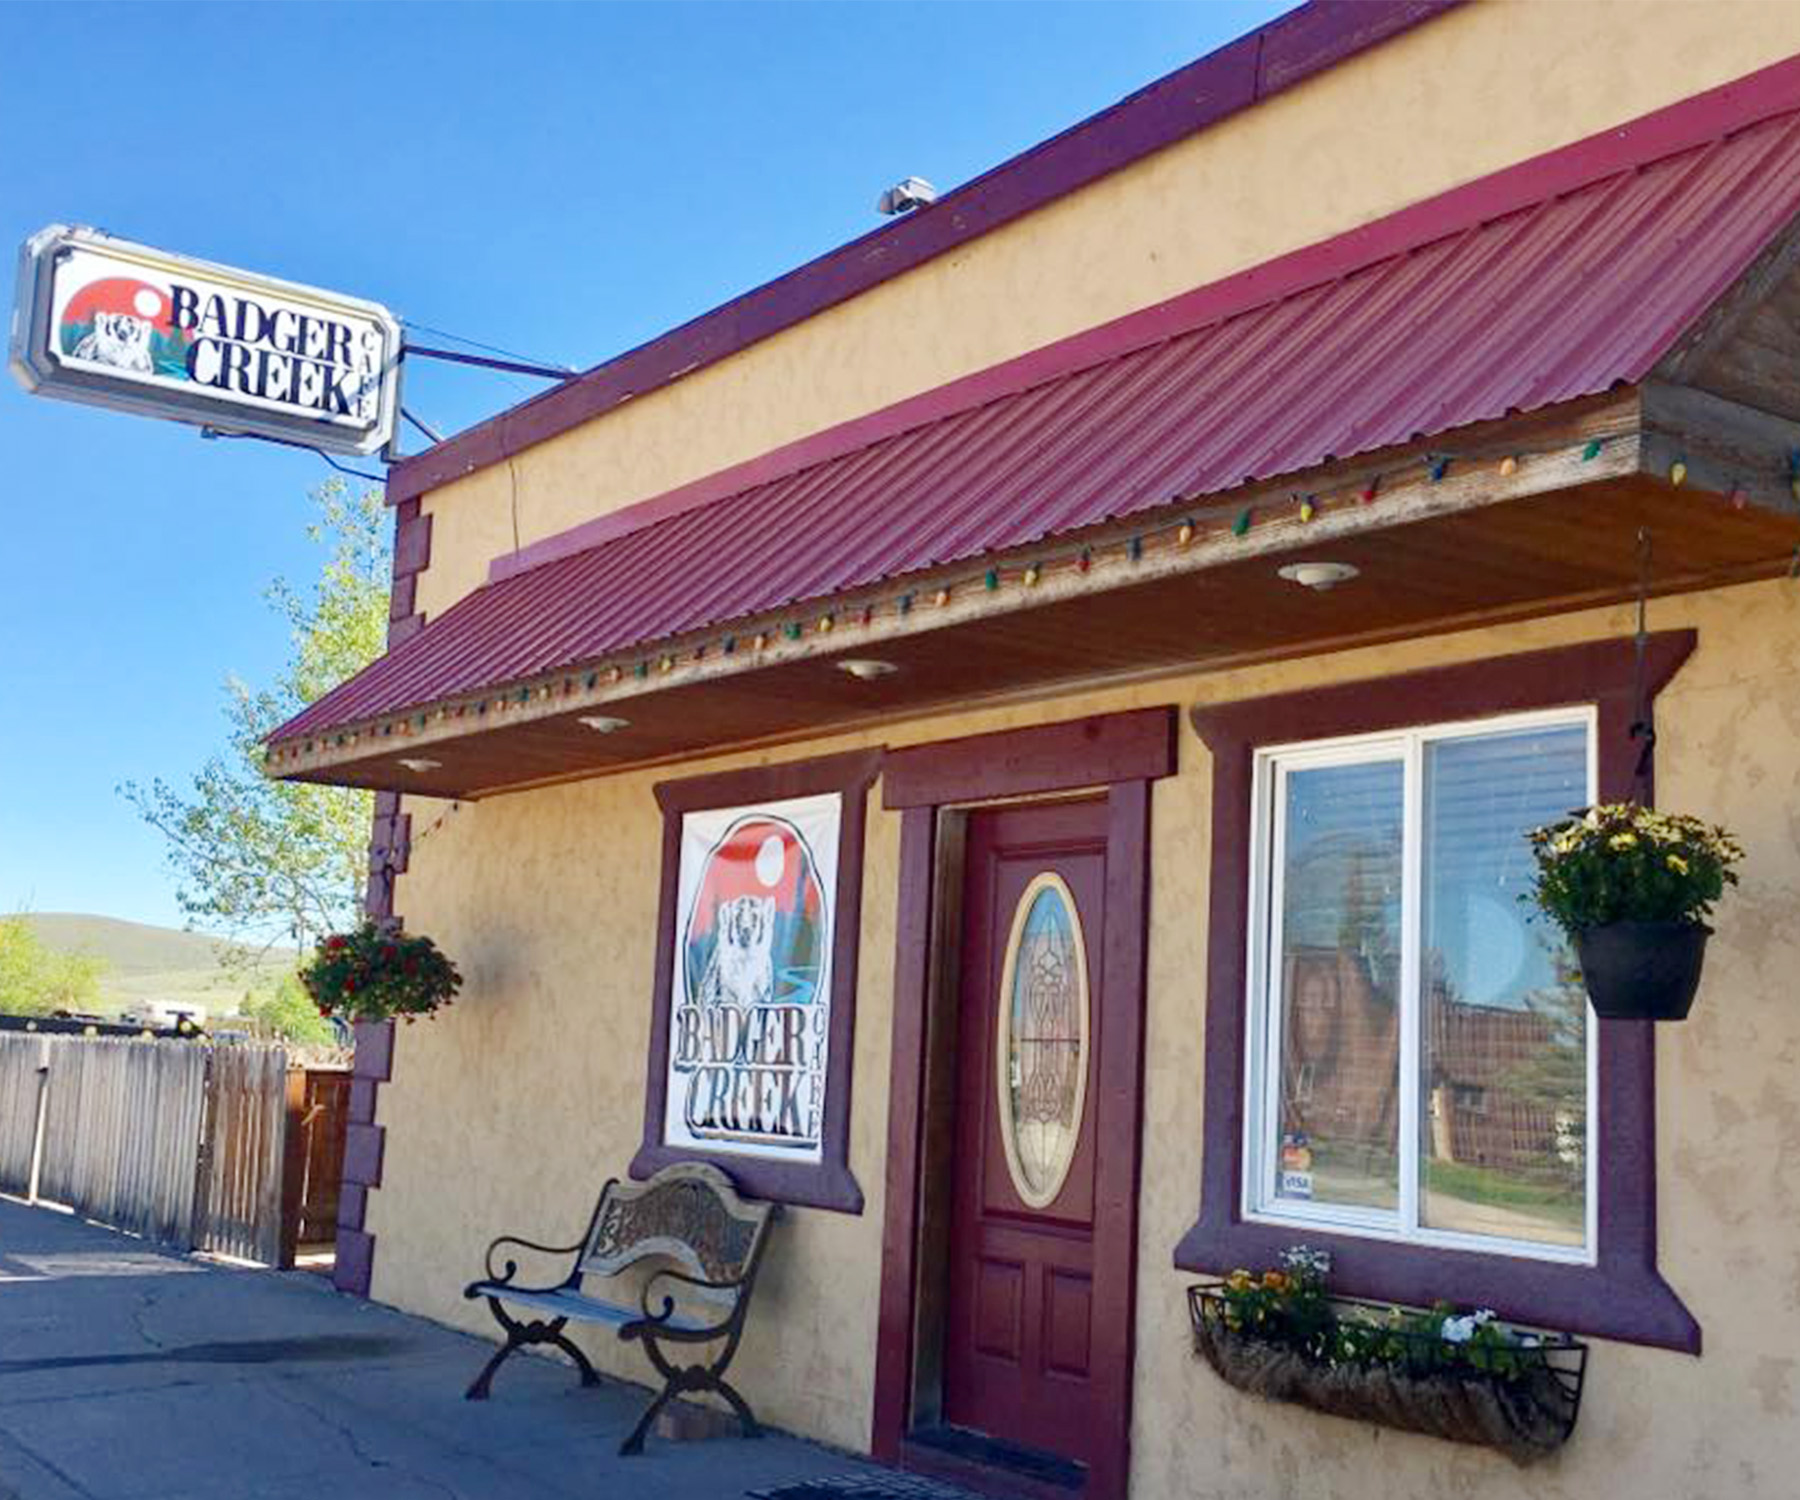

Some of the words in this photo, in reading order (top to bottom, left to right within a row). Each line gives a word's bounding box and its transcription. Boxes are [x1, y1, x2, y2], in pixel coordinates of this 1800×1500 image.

[167, 284, 353, 368] BADGER
[186, 338, 354, 416] CREEK
[357, 330, 375, 419] CAFE
[678, 1006, 806, 1066] BADGER
[689, 1066, 807, 1138] CREEK
